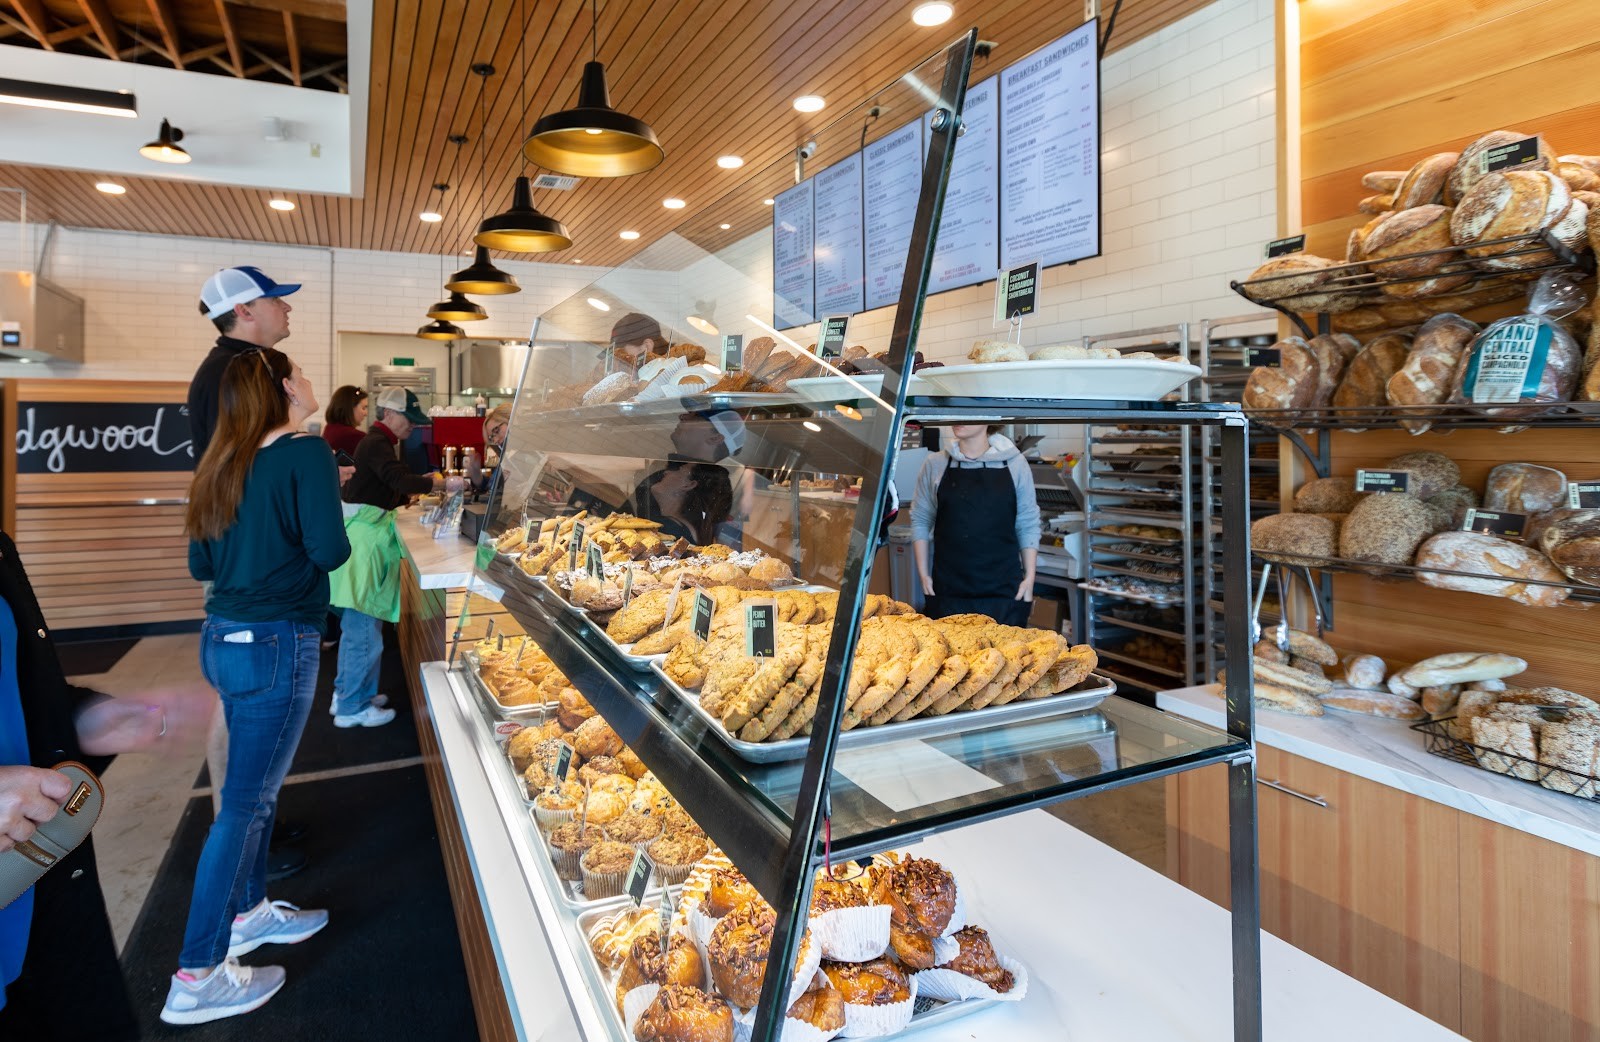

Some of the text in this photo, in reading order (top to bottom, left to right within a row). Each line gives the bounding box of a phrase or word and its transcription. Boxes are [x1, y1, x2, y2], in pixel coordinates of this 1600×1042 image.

[1008, 34, 1089, 86] BREAKFAST SANDWICHES
[1010, 270, 1029, 283] COCONUT
[1009, 278, 1034, 292] CARDAMOM
[1008, 287, 1033, 299] SHORTBREAD
[1484, 341, 1531, 353] CENTRAL
[16, 407, 191, 473] dgwood
